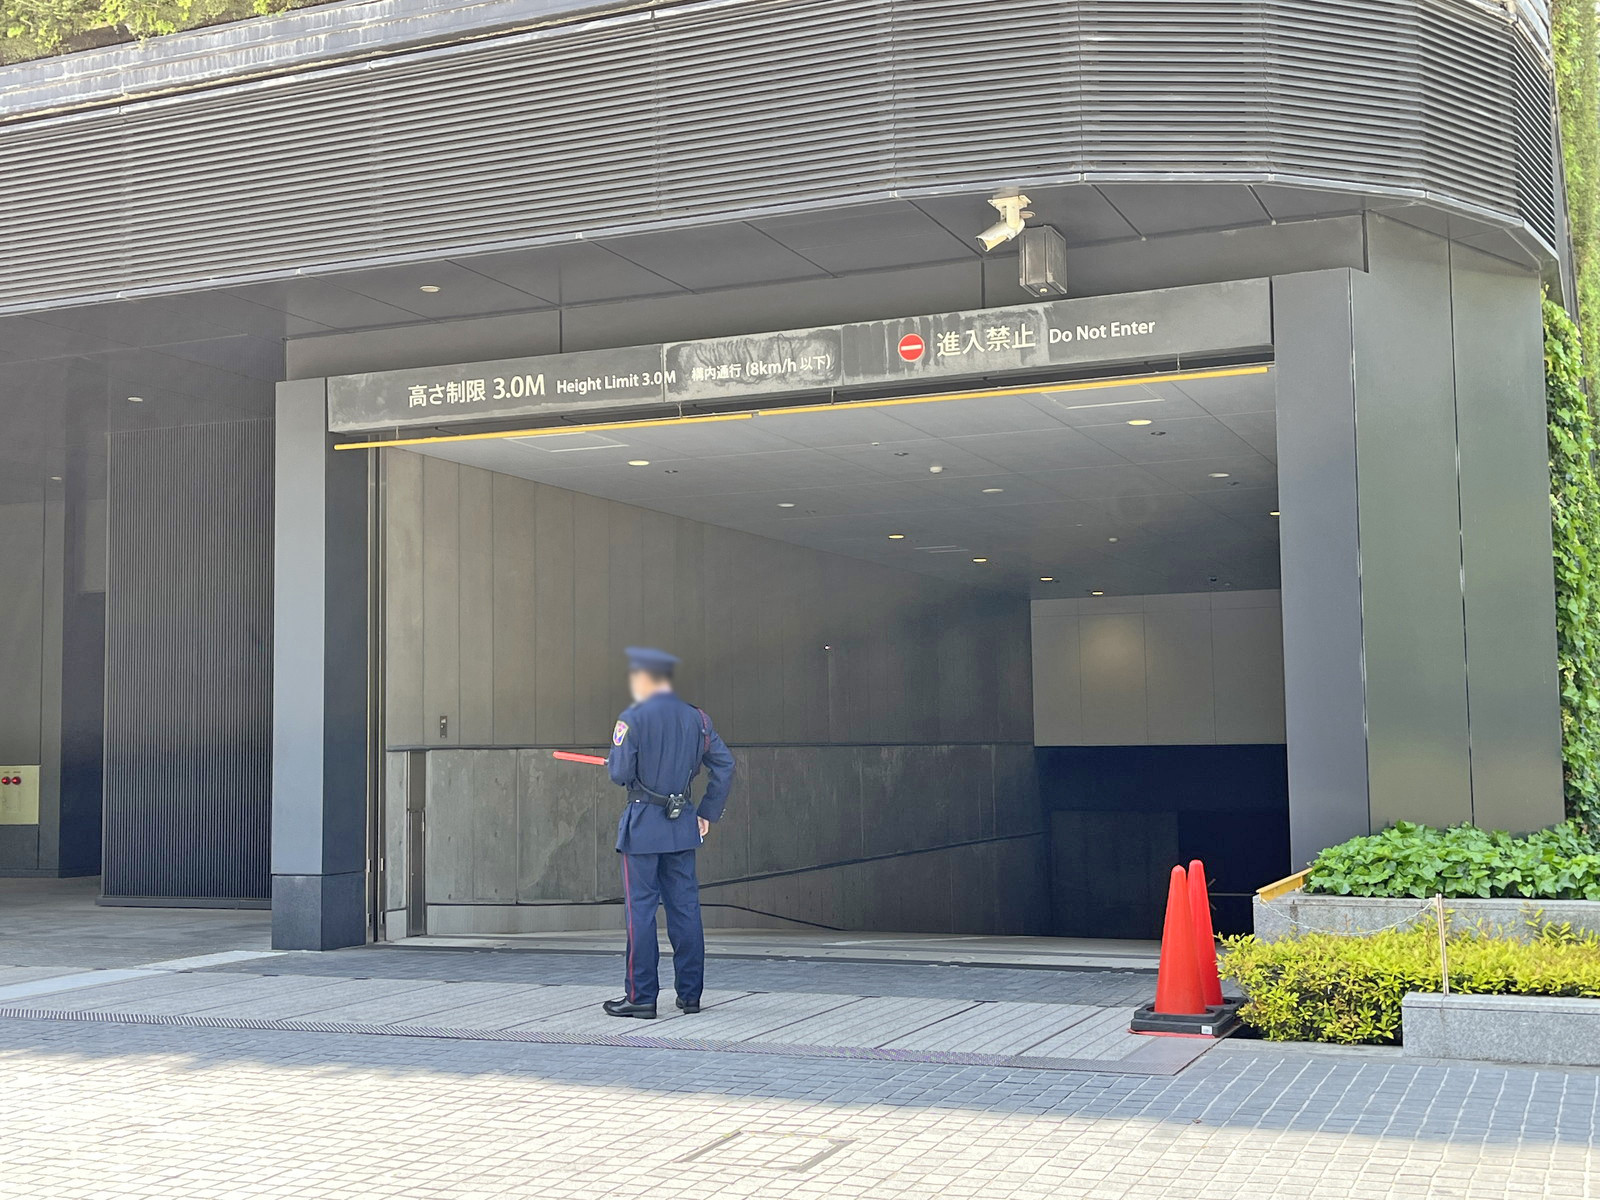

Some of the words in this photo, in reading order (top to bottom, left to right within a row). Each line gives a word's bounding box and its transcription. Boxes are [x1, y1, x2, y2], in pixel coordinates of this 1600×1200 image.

[936, 323, 1036, 357] 進入禁止
[1049, 328, 1073, 344] Do
[1076, 324, 1107, 340] Not
[1110, 321, 1156, 337] Enter
[691, 363, 742, 381] 構内通行
[745, 358, 797, 377] (8km/h
[800, 353, 831, 370] 以下)
[408, 378, 486, 408] 高さ制限
[493, 374, 545, 399] 3.0M
[556, 376, 601, 395] Height
[604, 373, 639, 389] Limit
[642, 370, 676, 386] 3.0M
